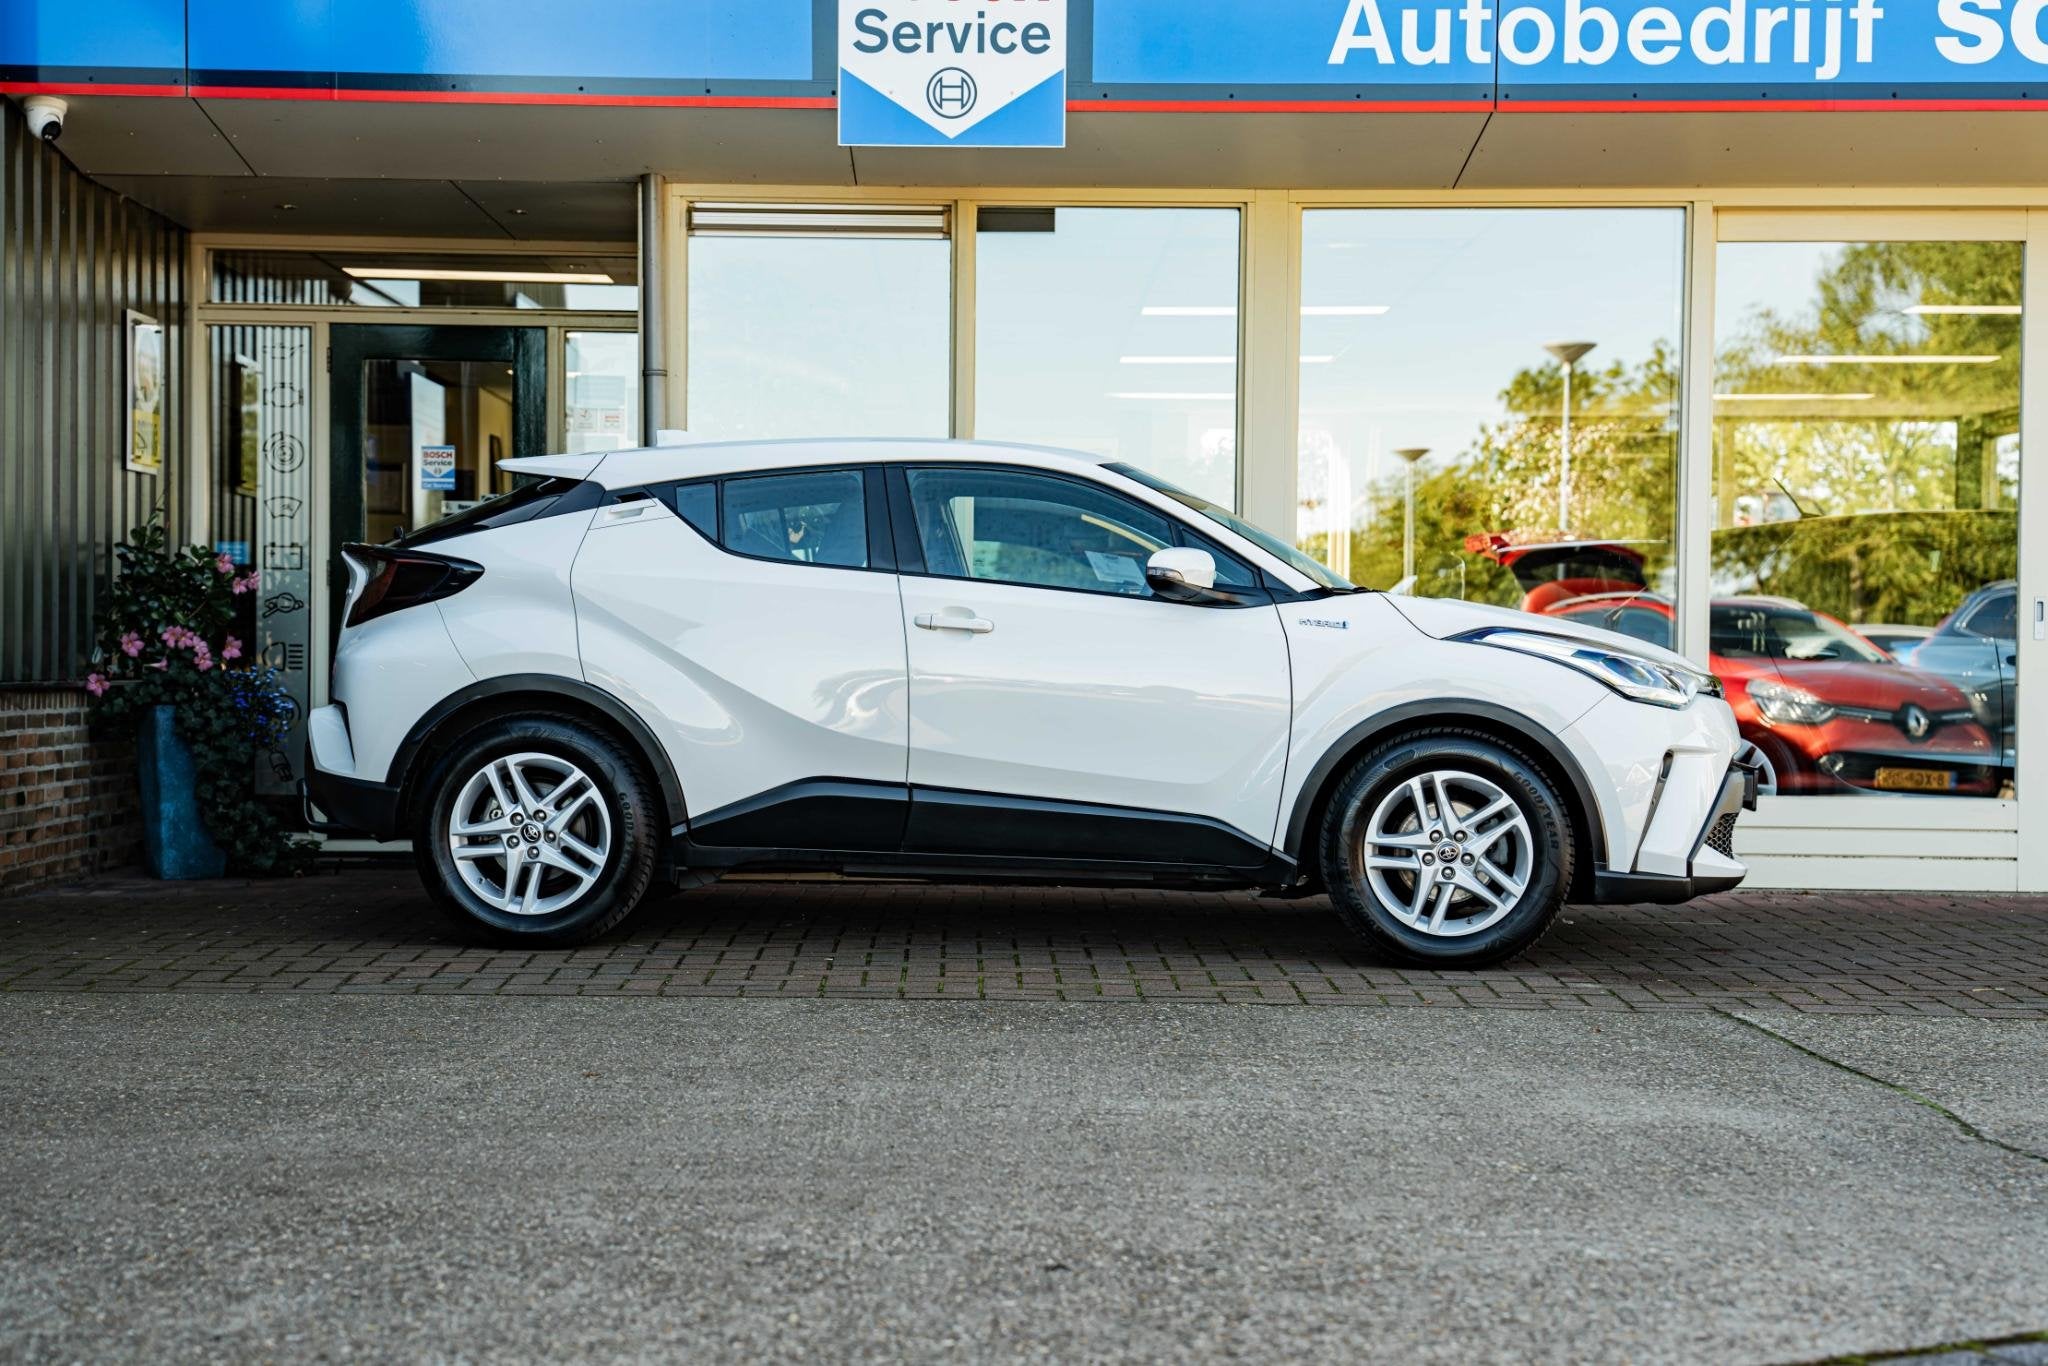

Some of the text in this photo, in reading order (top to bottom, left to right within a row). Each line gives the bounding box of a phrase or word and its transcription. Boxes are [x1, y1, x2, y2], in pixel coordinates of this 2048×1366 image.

[853, 8, 1051, 54] Service
[1327, 0, 1884, 80] Autobedrijf
[423, 451, 453, 459] BOSCH
[1513, 771, 1559, 850] GOODYEAR
